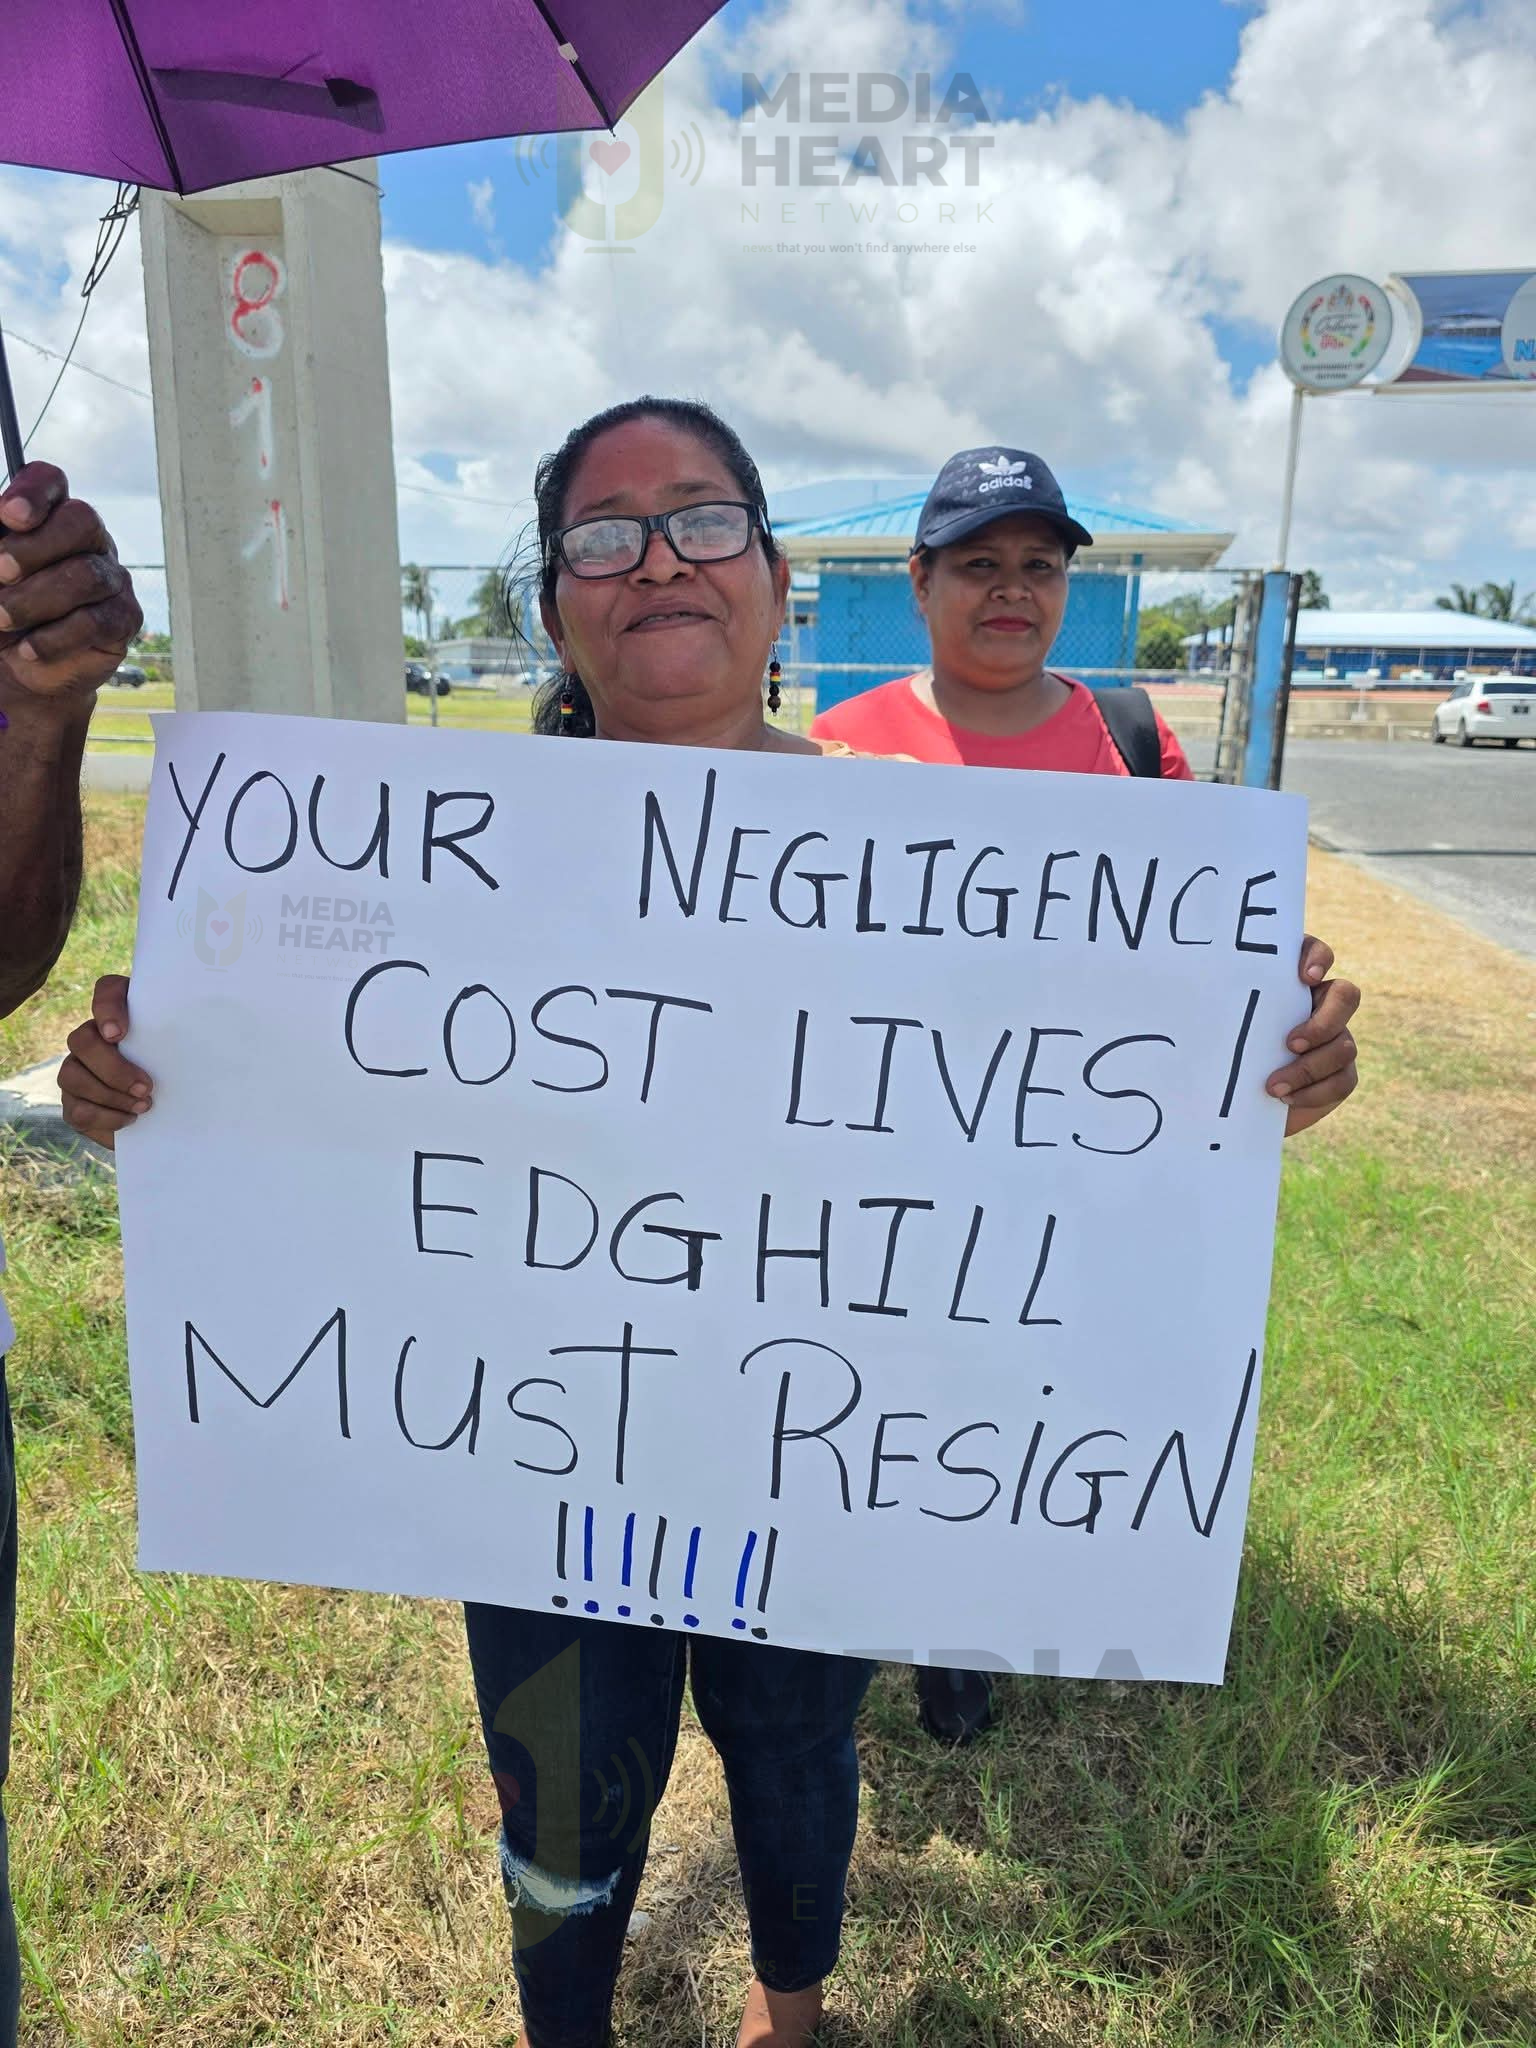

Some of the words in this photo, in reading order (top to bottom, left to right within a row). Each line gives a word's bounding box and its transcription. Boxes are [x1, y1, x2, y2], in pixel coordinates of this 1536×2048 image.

[978, 475, 1033, 494] adidas
[168, 753, 499, 901] YOUR
[639, 768, 1277, 955] NEGLIGENCE
[345, 960, 712, 1103] COST
[413, 1151, 1062, 1325] EDGHILL
